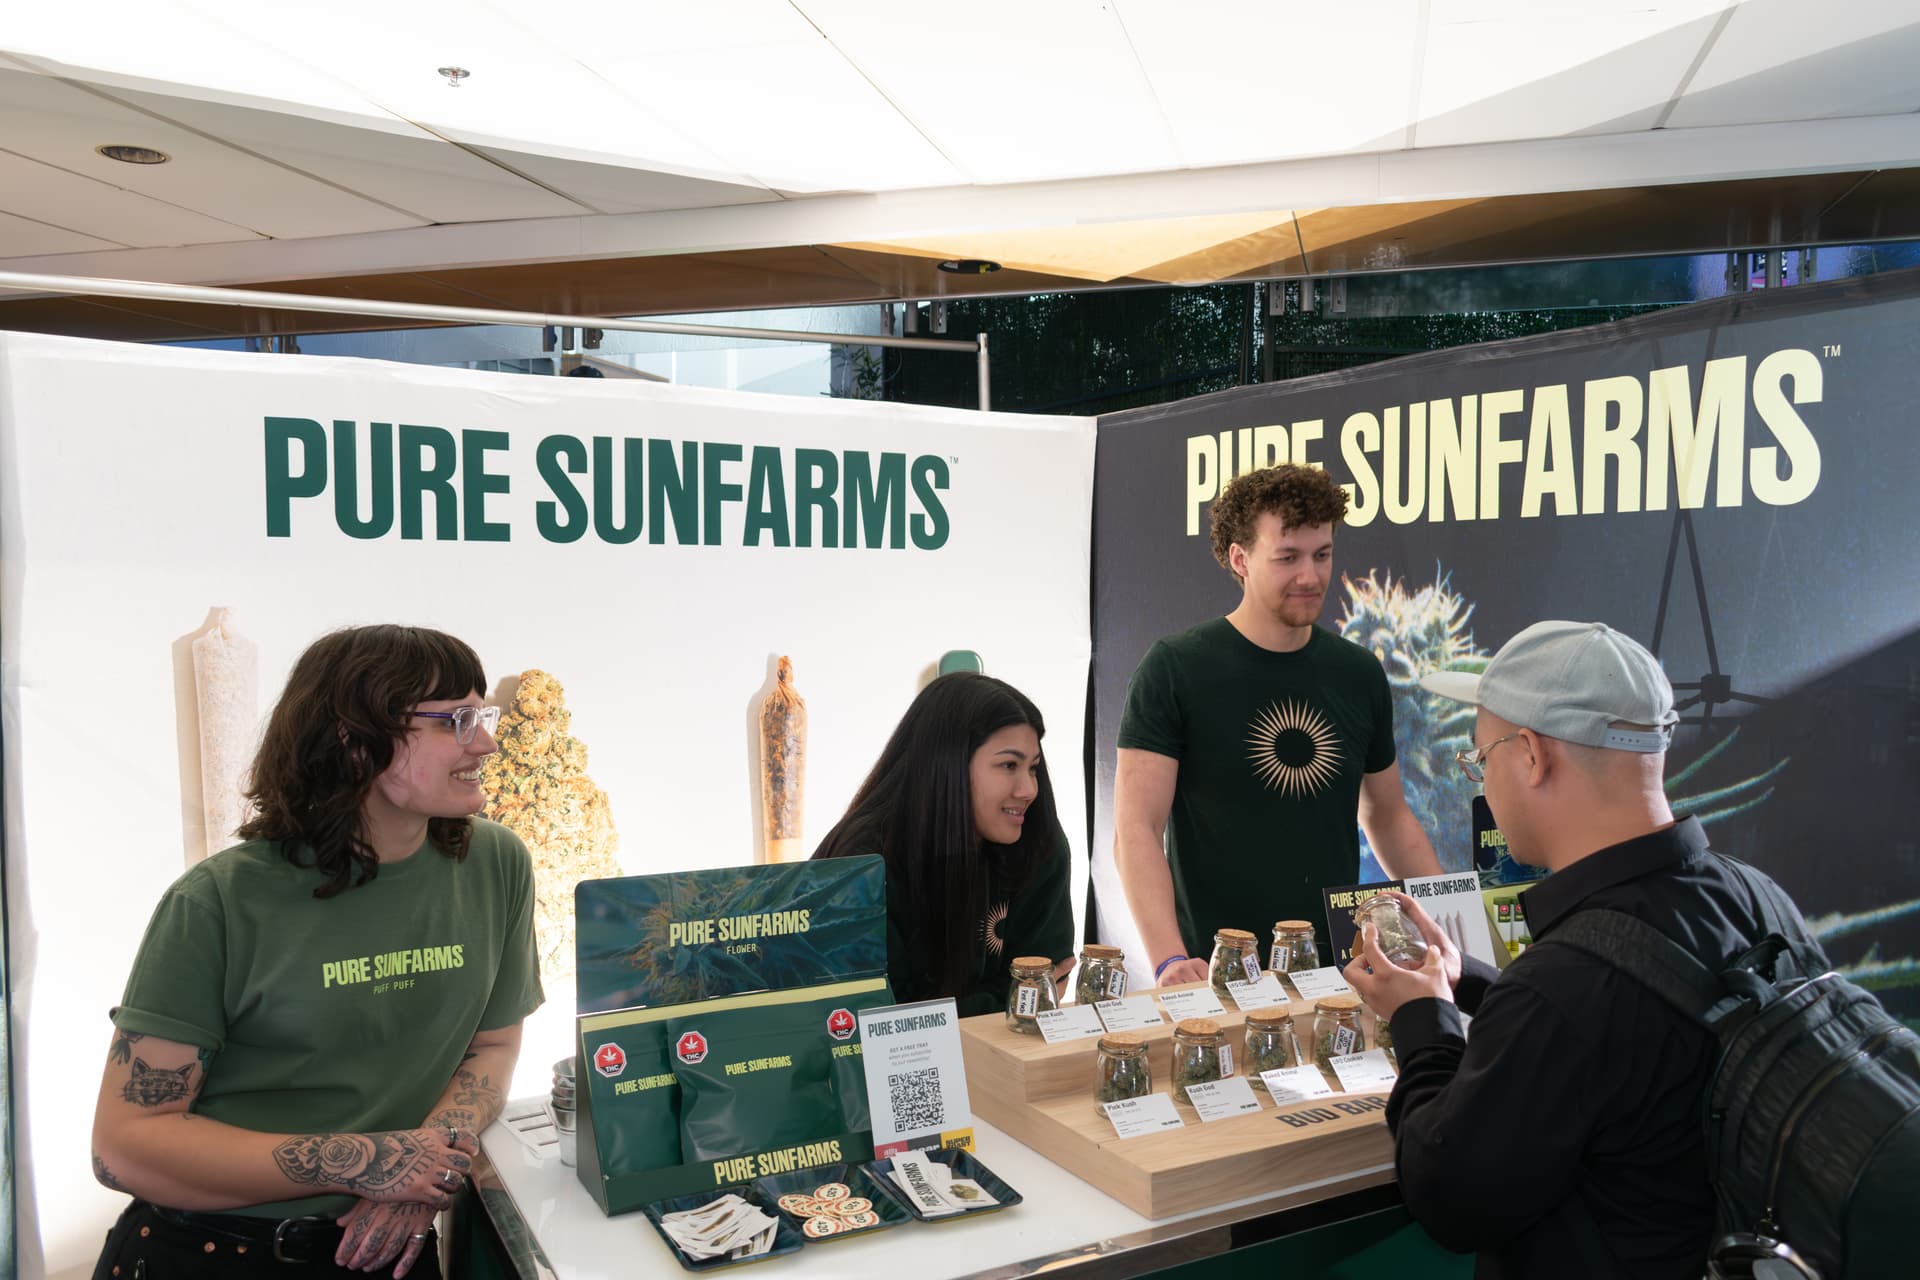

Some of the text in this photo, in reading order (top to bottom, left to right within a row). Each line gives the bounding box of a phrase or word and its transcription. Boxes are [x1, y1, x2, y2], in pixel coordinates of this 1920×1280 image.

[1340, 349, 1822, 527] SUNFARMS
[264, 416, 511, 542] PURE
[536, 434, 950, 550] SUNFARMS
[1410, 878, 1476, 898] PURE SUNFARMS
[1330, 892, 1354, 909] PURE
[670, 909, 810, 947] PURE SUNFARMS
[726, 943, 757, 955] FLOWER
[322, 944, 464, 988] PURE SUNFARMS
[373, 979, 415, 994] PUFF PUFF
[868, 1012, 947, 1038] PURE SUNFARMS
[686, 1053, 700, 1061] THC
[832, 1044, 854, 1059] PURE
[605, 1064, 620, 1073] THC
[725, 1056, 792, 1076] PURE SUNFARMS
[615, 1079, 638, 1096] PURE
[1275, 1108, 1341, 1128] BUD
[713, 1140, 842, 1185] PURE SUNFARMS
